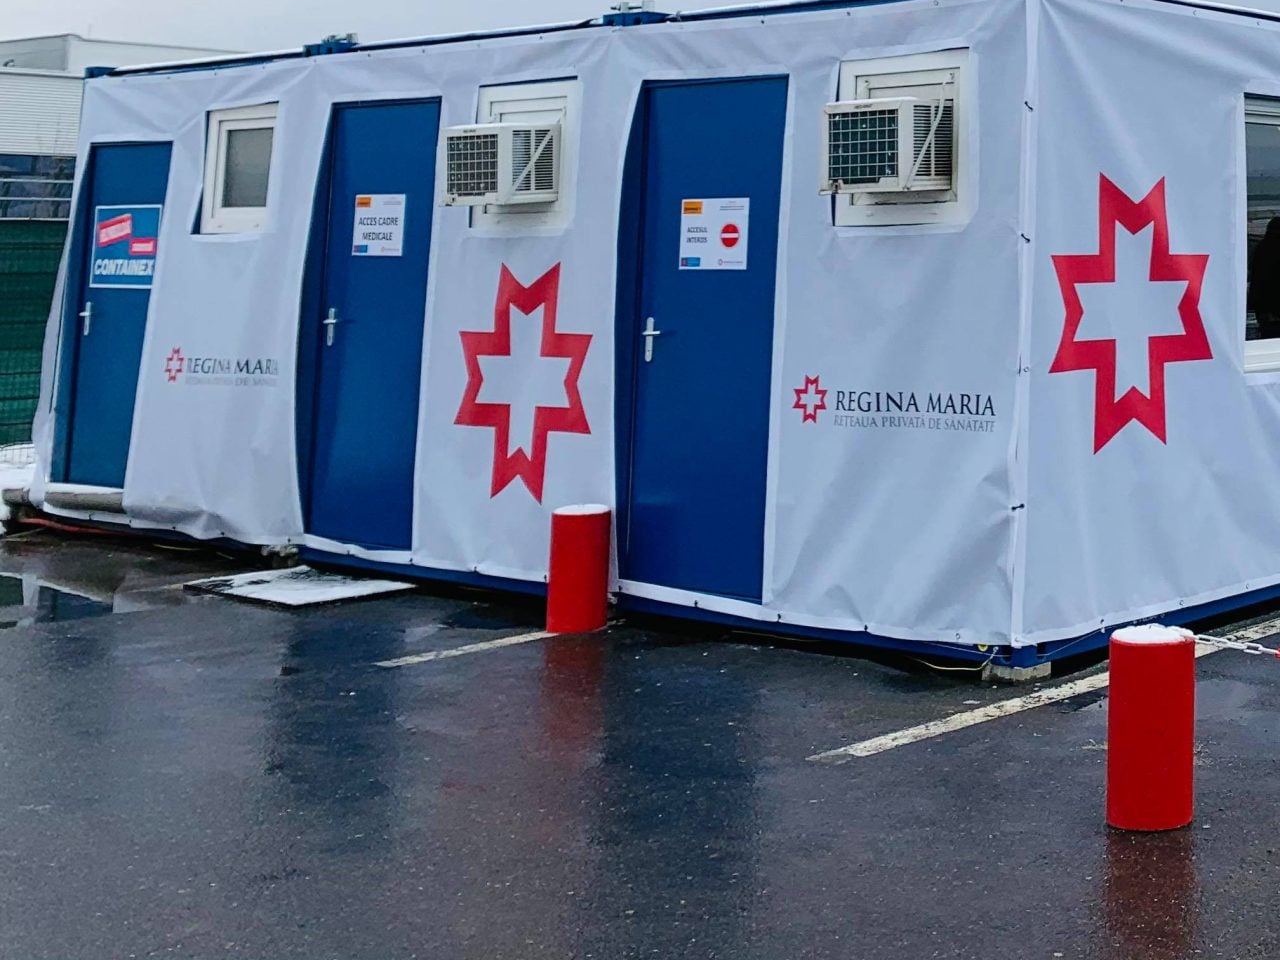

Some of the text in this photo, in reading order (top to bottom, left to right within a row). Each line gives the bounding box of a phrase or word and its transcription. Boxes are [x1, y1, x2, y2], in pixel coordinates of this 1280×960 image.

[358, 217, 399, 226] ACCES CADRE
[362, 232, 393, 241] MEDICALE
[94, 258, 155, 276] CONTAINEX
[835, 390, 996, 417] REGINA MARIA
[928, 416, 942, 430] DE
